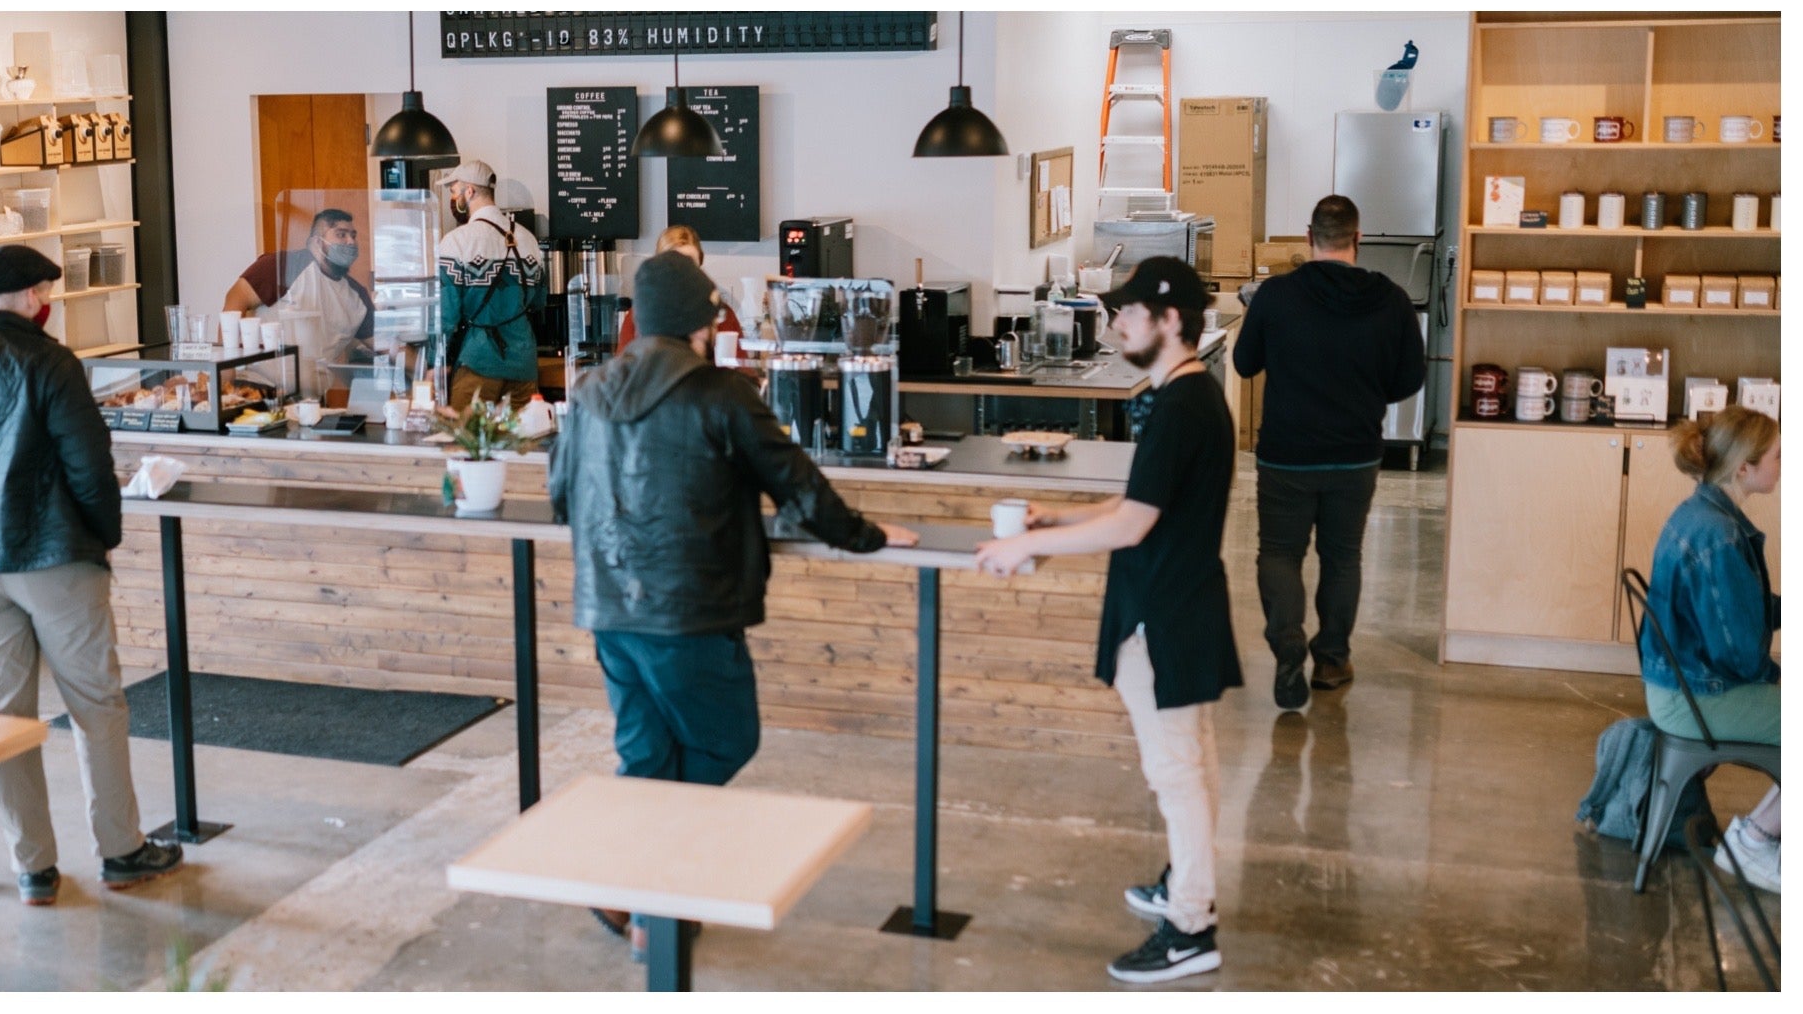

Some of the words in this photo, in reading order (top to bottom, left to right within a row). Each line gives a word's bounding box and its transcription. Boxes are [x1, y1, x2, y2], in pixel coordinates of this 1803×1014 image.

[589, 28, 628, 46] 83%
[648, 26, 763, 44] HUMIDITY
[575, 92, 605, 100] COFFEE
